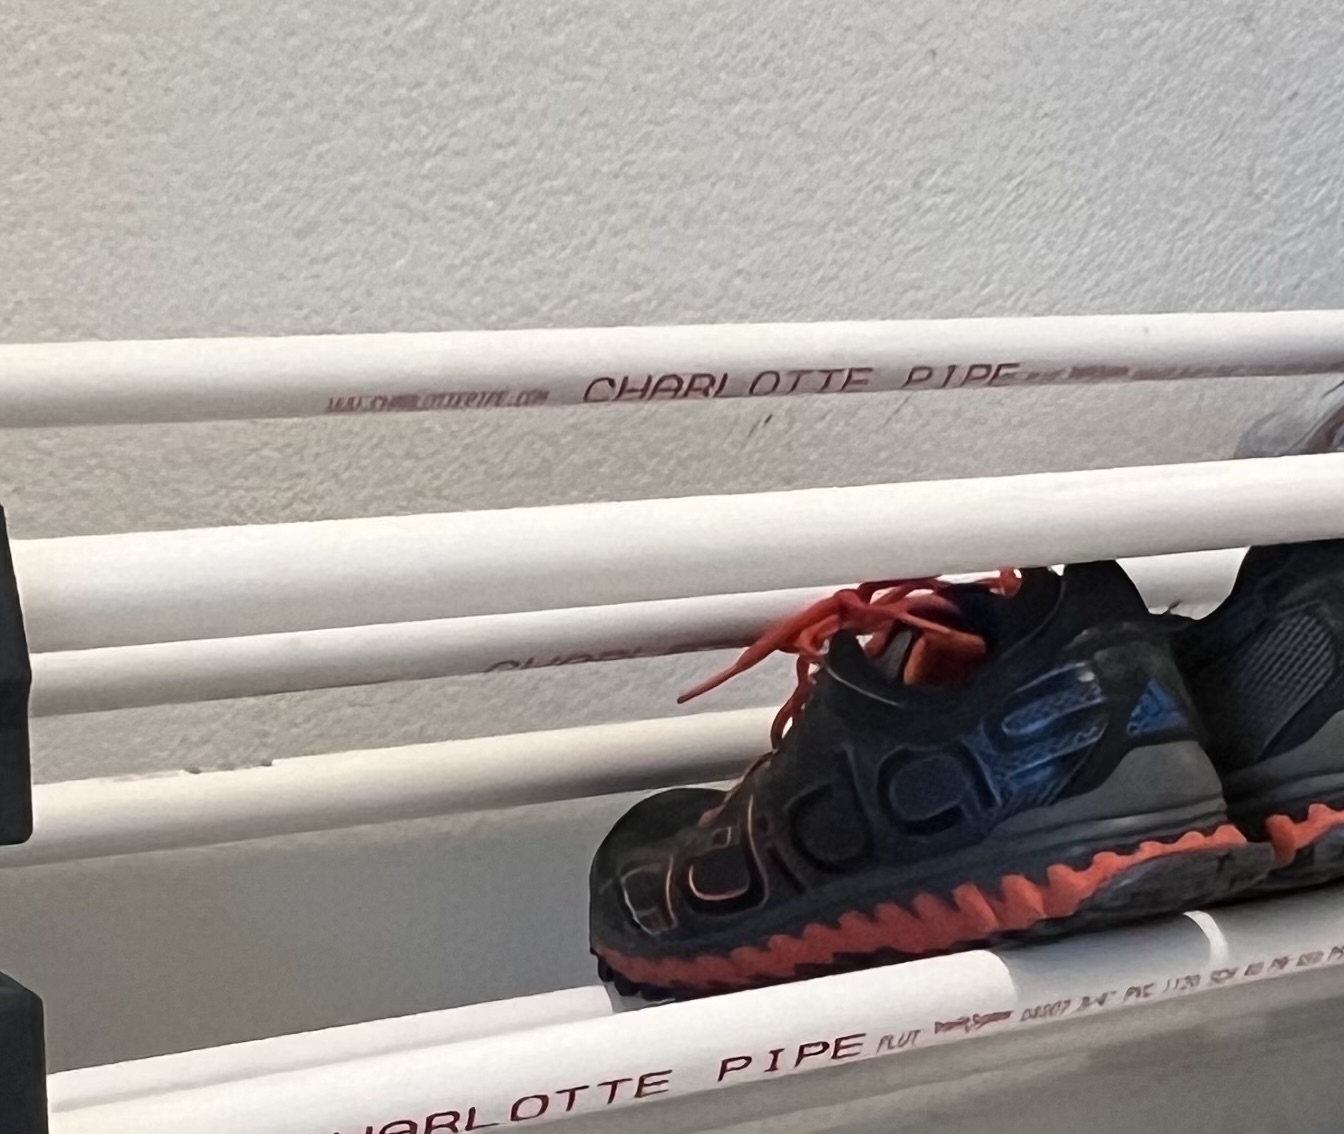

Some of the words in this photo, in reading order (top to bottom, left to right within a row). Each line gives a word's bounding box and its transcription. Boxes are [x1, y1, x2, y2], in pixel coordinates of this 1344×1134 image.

[583, 366, 874, 401] CHARLOTTE
[902, 362, 1022, 389] PIPE
[716, 1032, 868, 1083] PIPE
